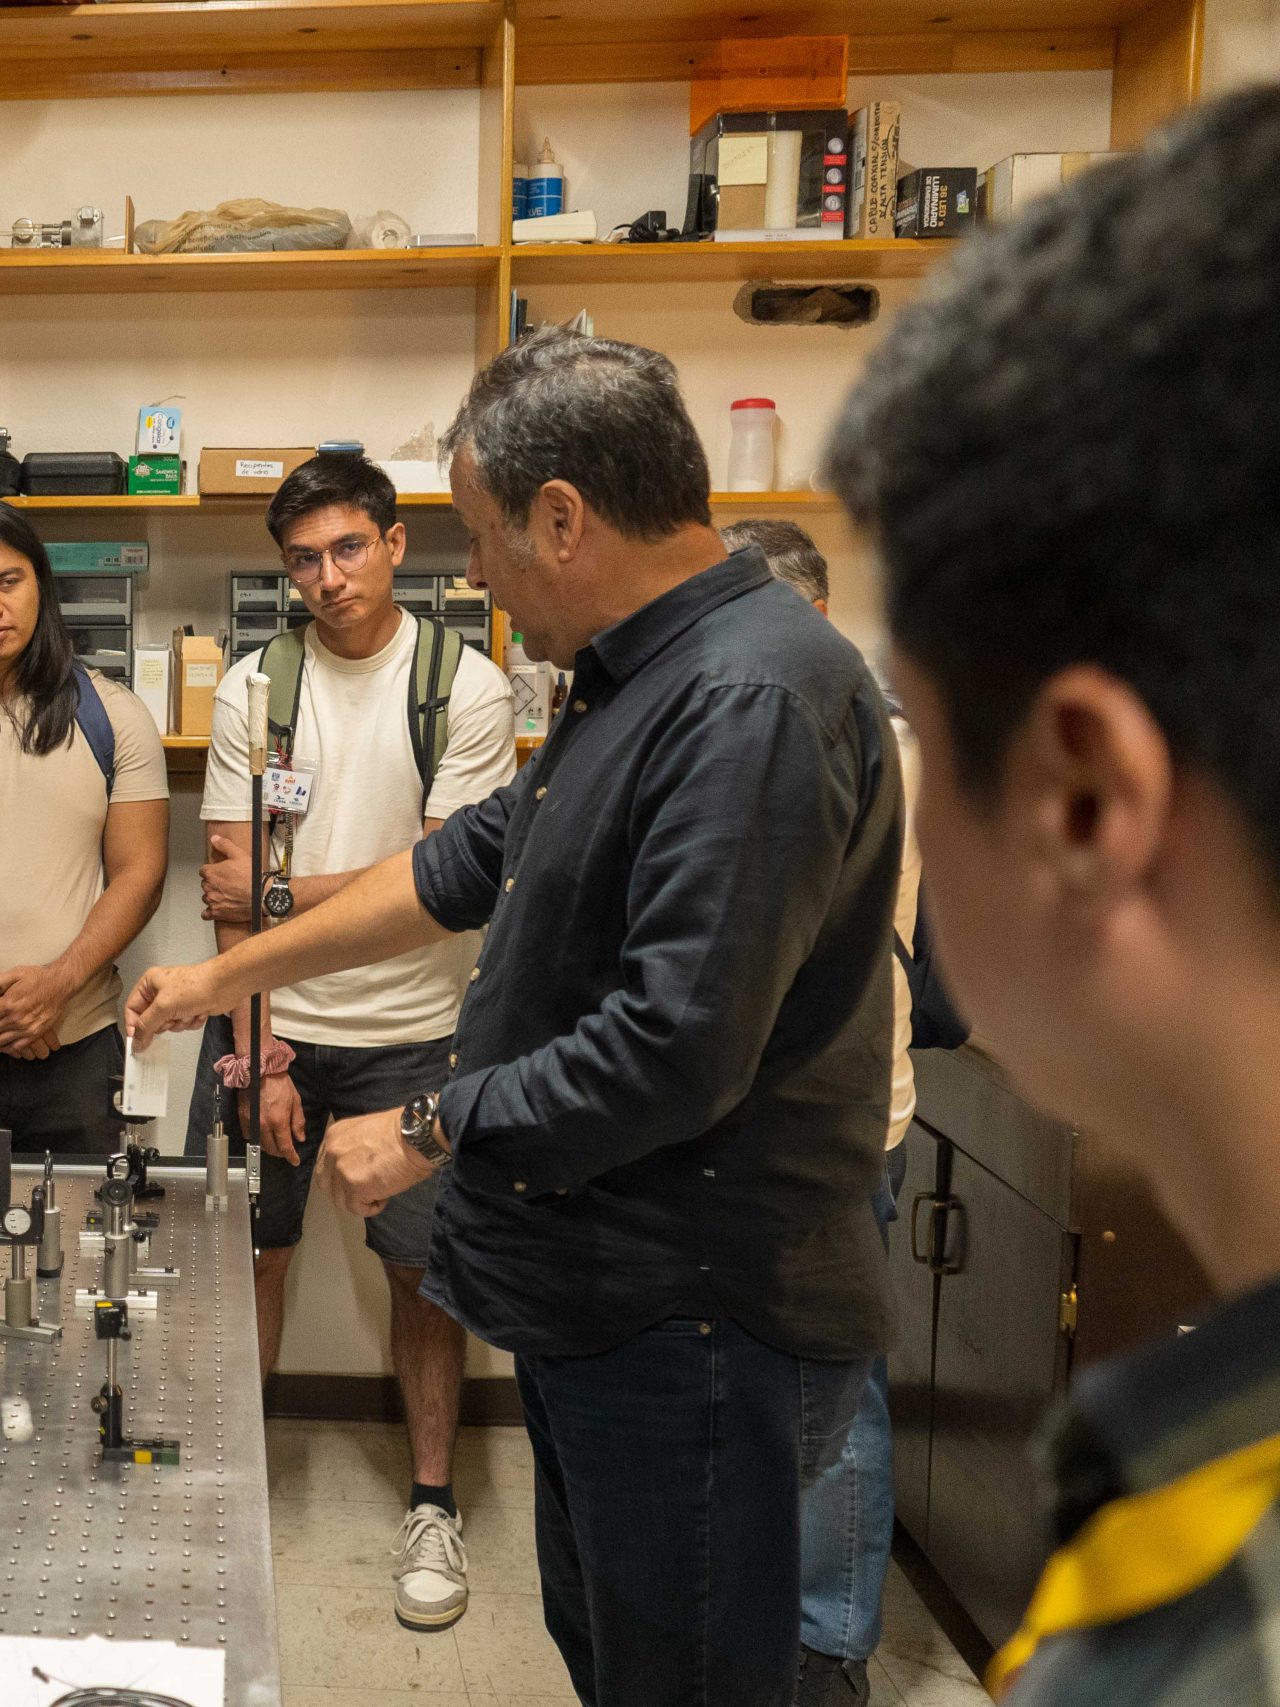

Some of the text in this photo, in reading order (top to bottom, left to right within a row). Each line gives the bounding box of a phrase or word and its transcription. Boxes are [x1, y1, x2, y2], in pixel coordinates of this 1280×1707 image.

[870, 153, 880, 194] COAXIAL
[939, 185, 948, 198] 36
[868, 197, 879, 234] CABLE
[923, 175, 932, 228] DE EMERGENCIA
[929, 175, 940, 228] LUMINARIO
